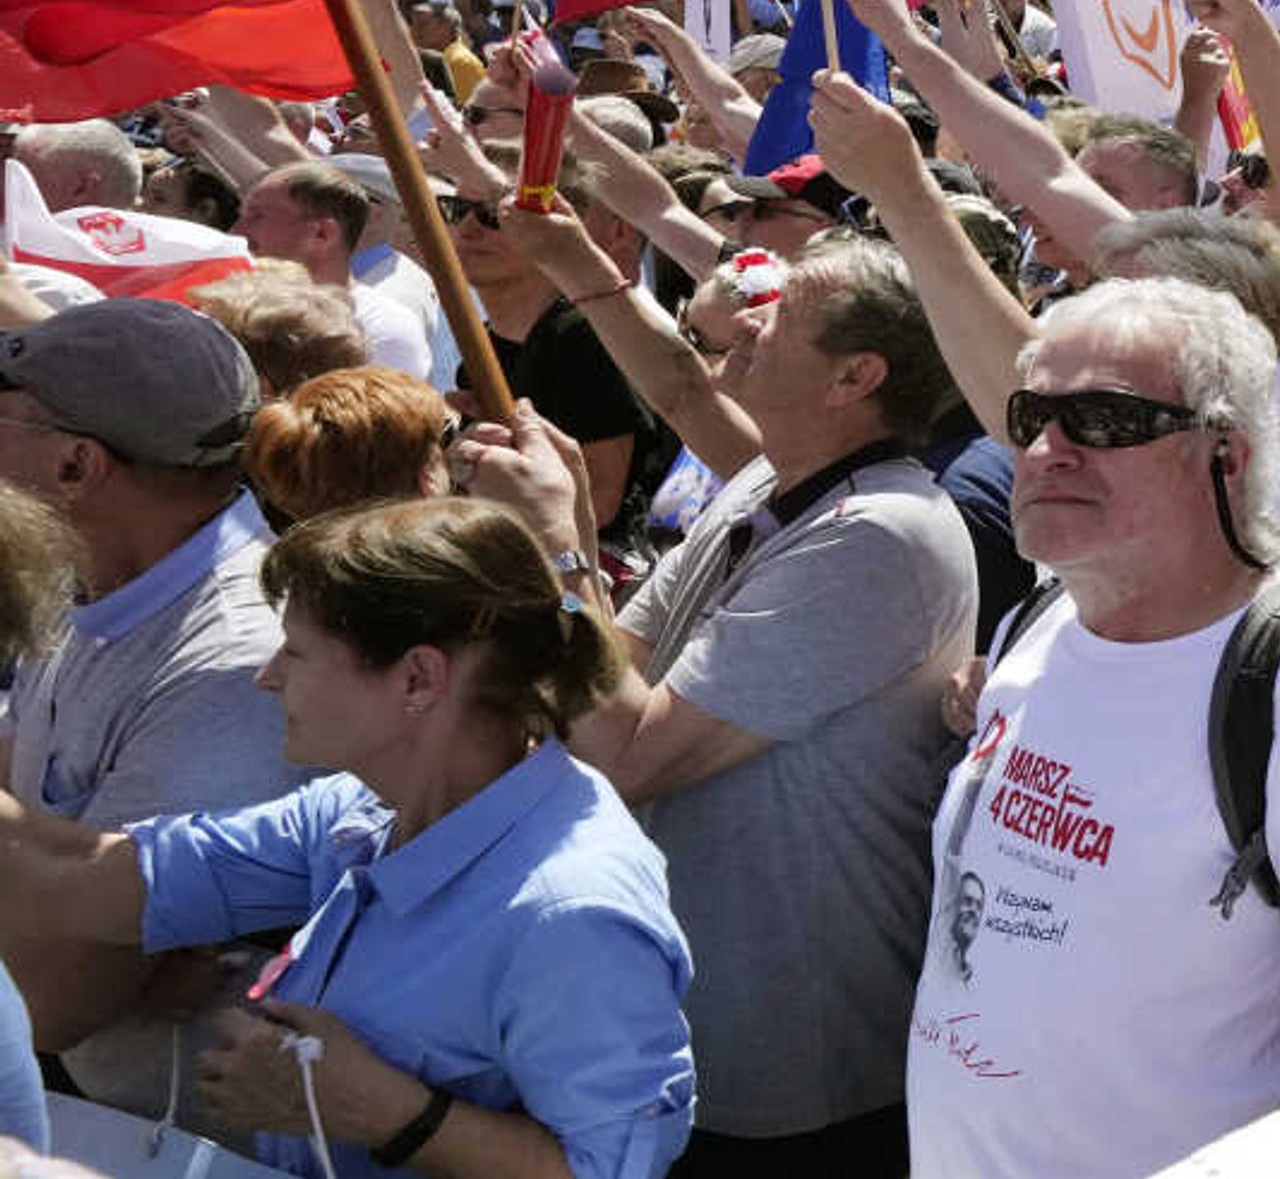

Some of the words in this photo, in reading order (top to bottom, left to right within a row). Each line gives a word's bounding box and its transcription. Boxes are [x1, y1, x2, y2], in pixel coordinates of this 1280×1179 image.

[1003, 744, 1072, 799] MARSZ
[990, 784, 1007, 824] 4
[1003, 782, 1115, 867] CZERWCA
